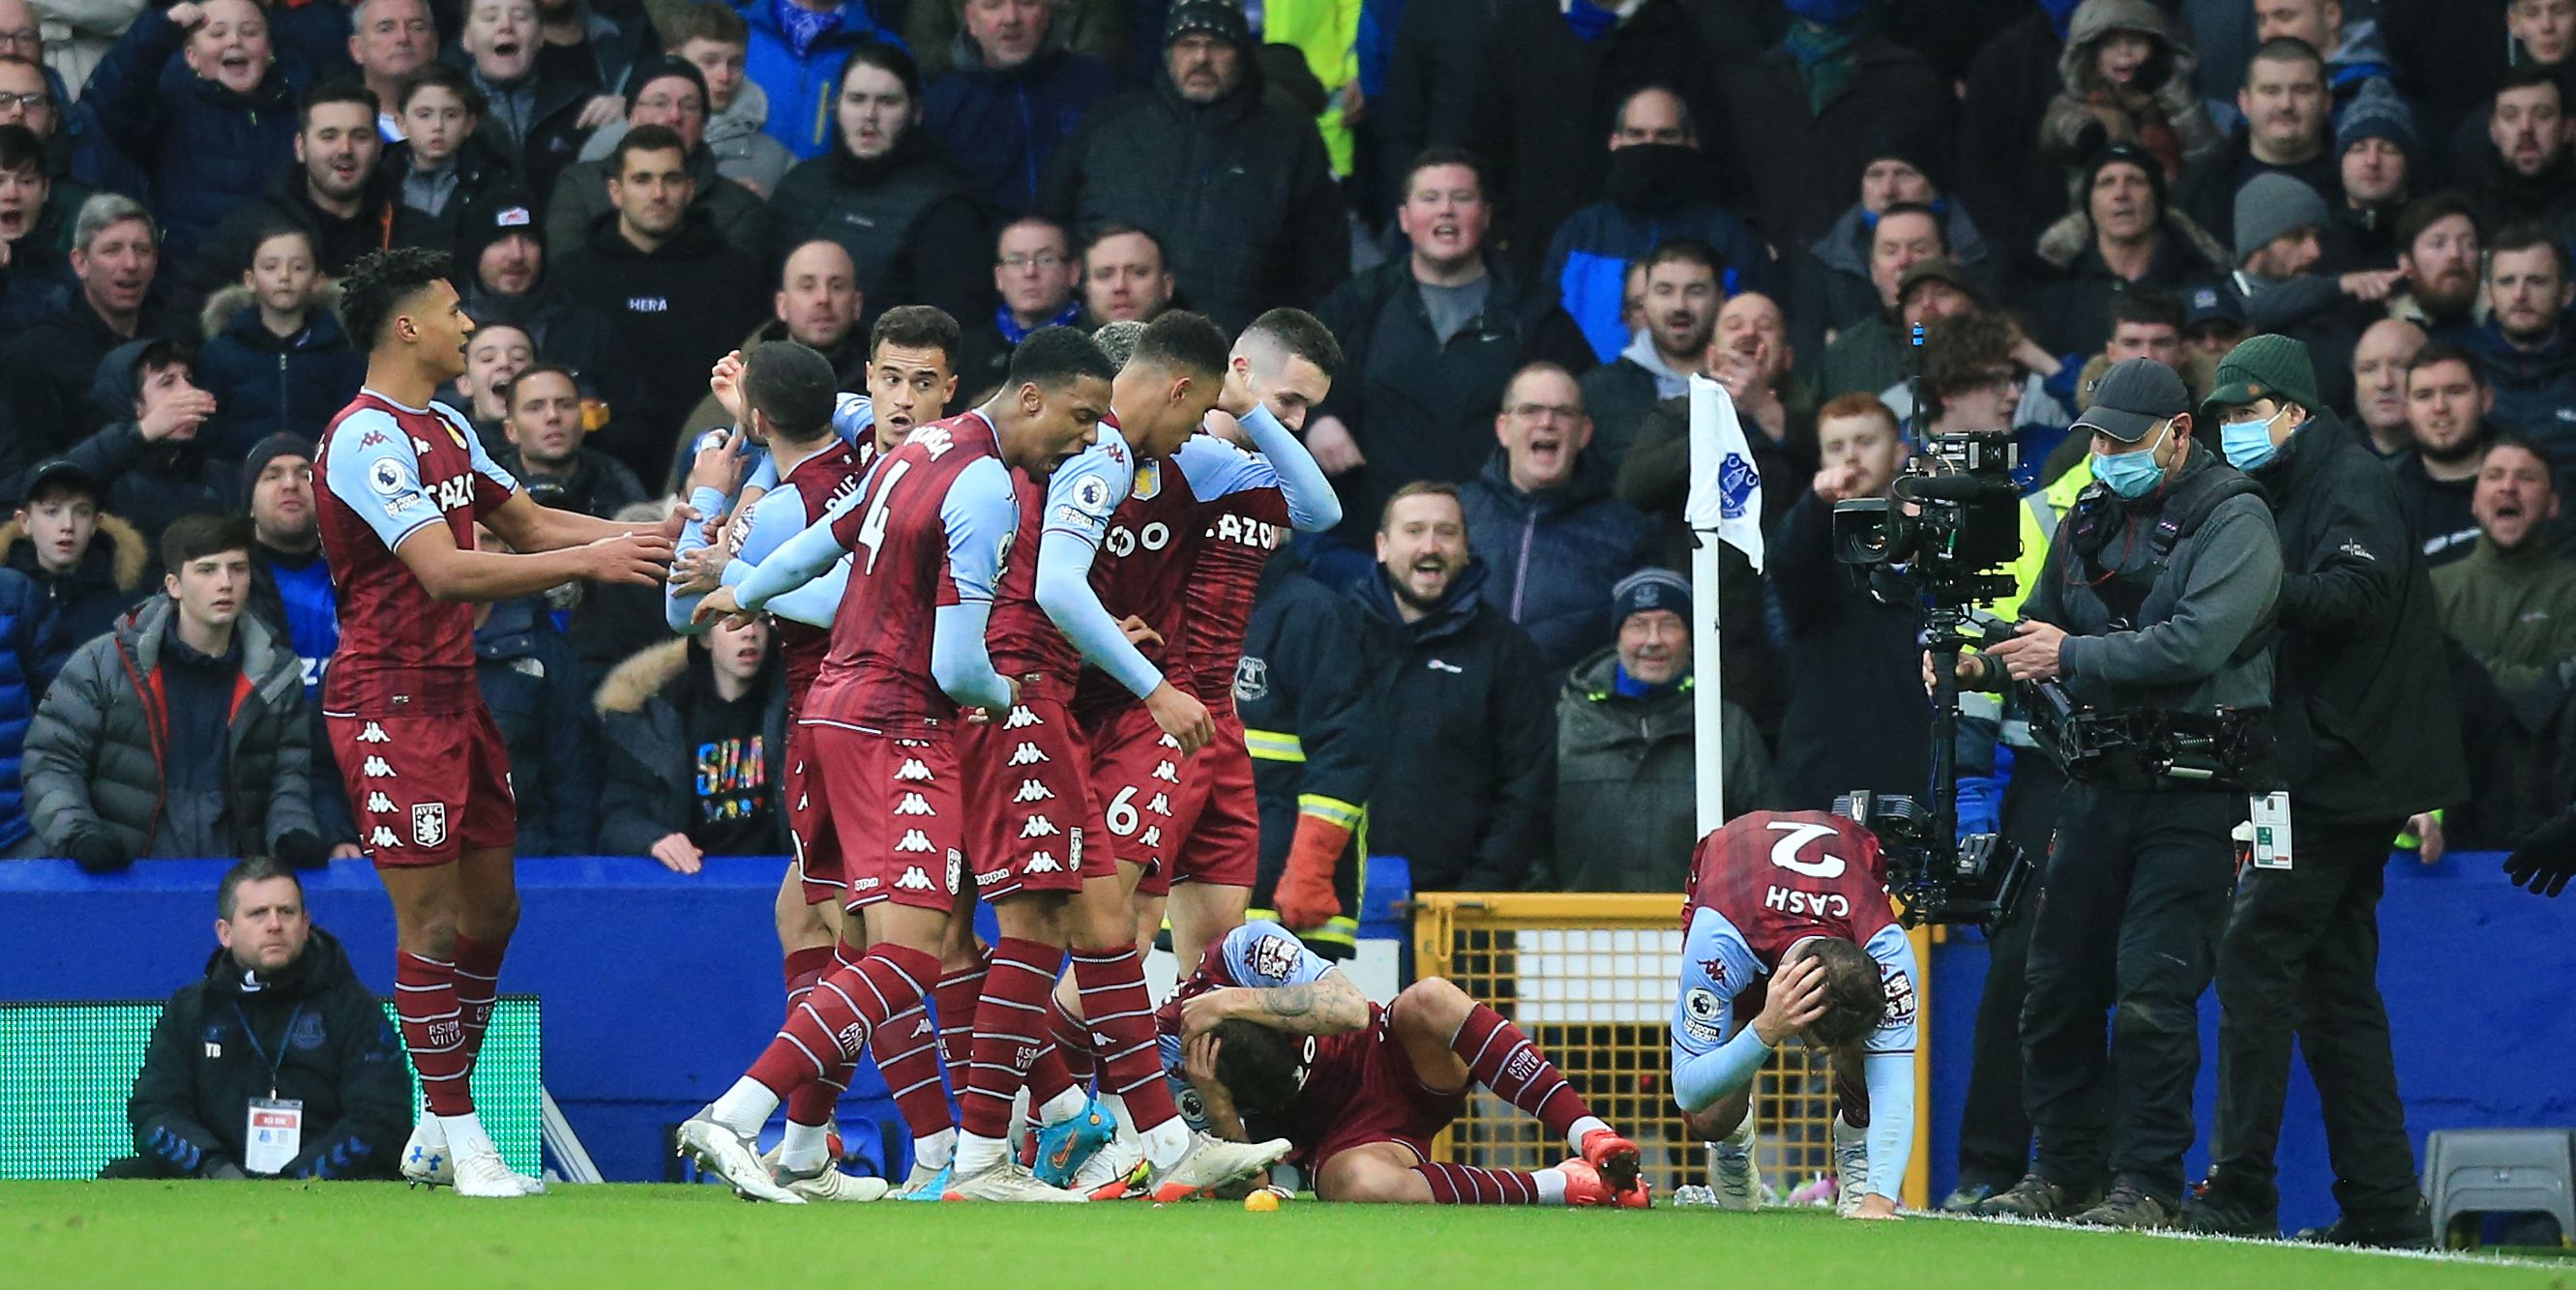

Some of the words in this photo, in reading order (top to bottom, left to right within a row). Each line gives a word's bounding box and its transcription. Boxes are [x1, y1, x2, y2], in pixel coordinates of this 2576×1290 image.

[630, 297, 667, 311] HERA
[858, 458, 911, 576] 4
[1106, 785, 1140, 837] 6
[1765, 821, 1846, 878] 2
[1763, 885, 1850, 918] CASH
[204, 1041, 222, 1058] TB
